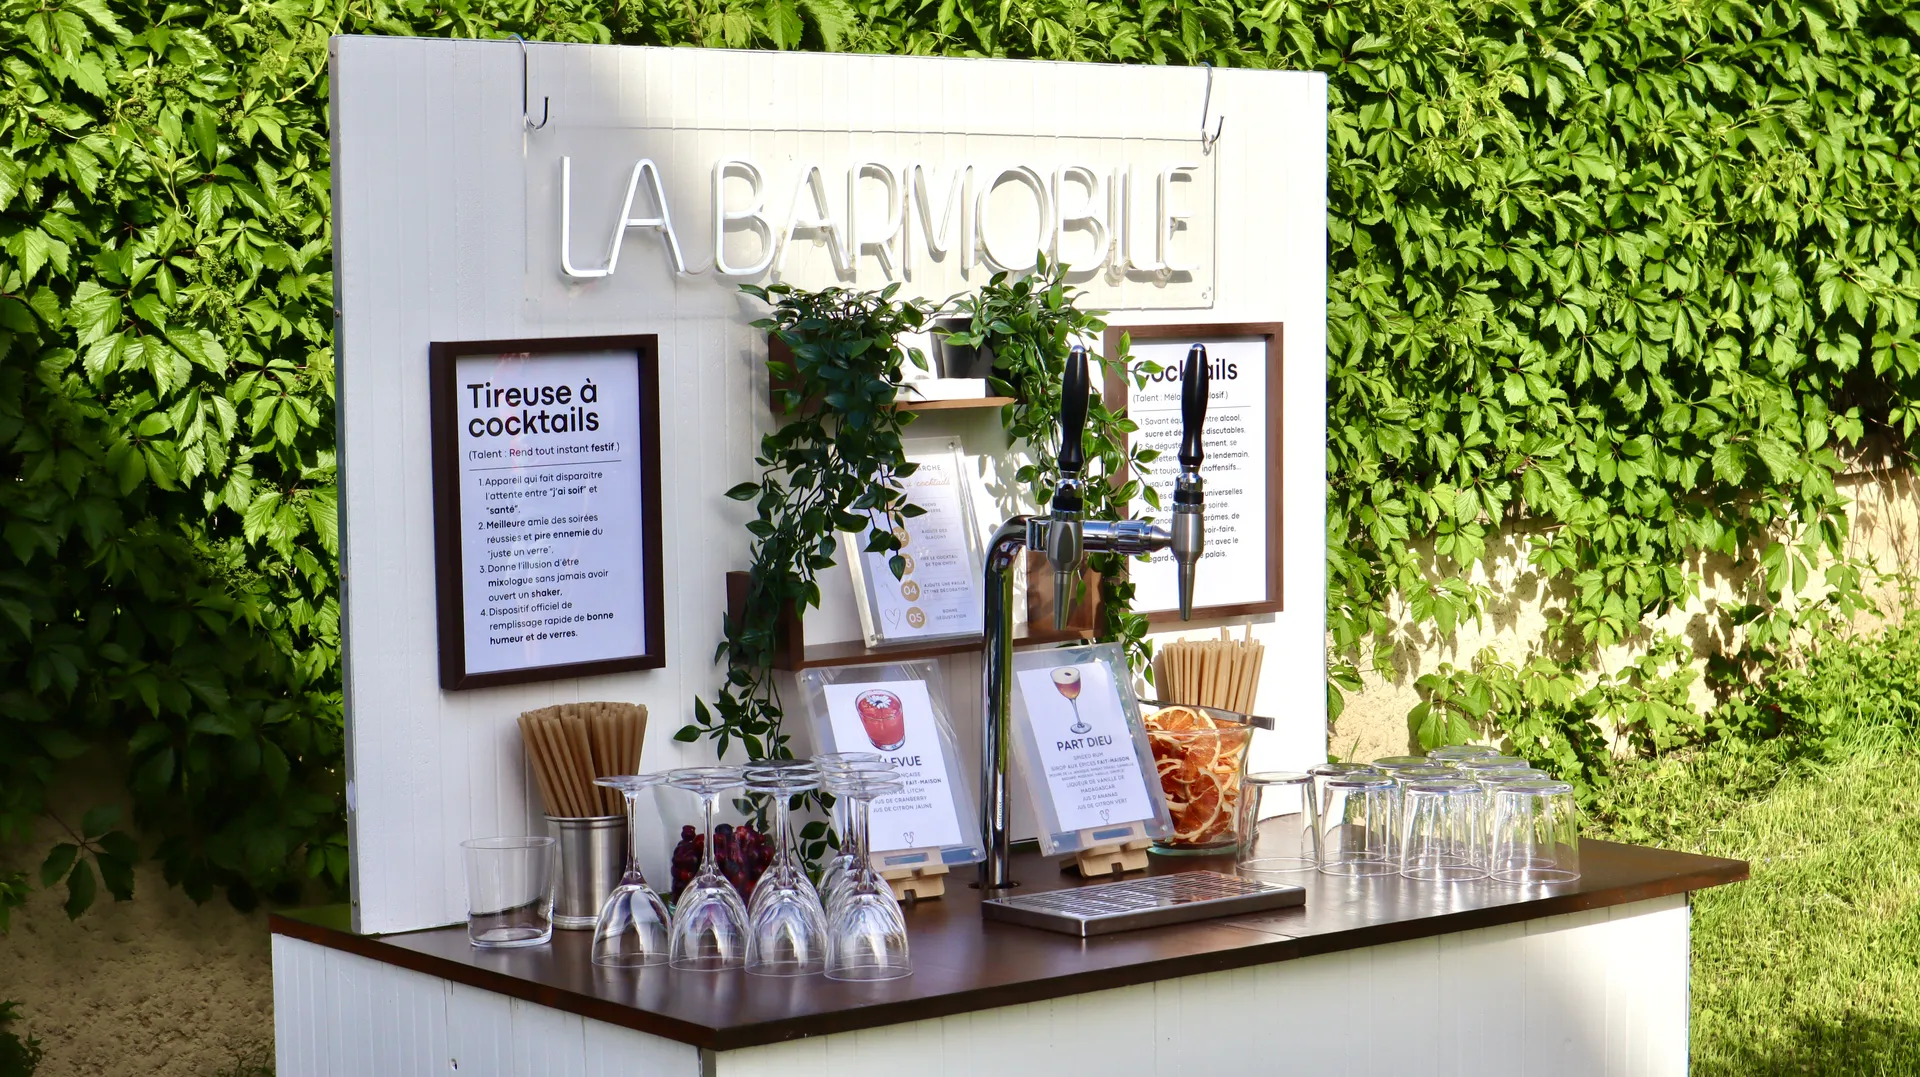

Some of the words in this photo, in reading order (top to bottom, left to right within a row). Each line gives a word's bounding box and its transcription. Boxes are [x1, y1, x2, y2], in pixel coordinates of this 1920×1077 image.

[560, 155, 686, 277] LA
[714, 159, 1200, 277] BARMOBILE
[1134, 358, 1238, 383] ockails
[467, 381, 572, 409] Tireuse
[580, 378, 598, 403] à
[1133, 393, 1159, 404] (Talent
[1164, 392, 1181, 401] Méla
[1209, 390, 1228, 400] losif.)
[468, 406, 600, 438] cocktails
[1145, 417, 1169, 426] Savant
[1165, 429, 1172, 437] et
[469, 449, 502, 461] (Talent
[509, 447, 533, 457] Rend
[535, 446, 555, 456] tout
[556, 444, 589, 455] instant
[591, 441, 620, 453] festif.)
[1205, 452, 1212, 460] le
[1159, 466, 1181, 476] toujou
[485, 475, 522, 489] Appareil
[524, 474, 538, 485] qui
[539, 472, 555, 483] fait
[485, 490, 523, 501] l'attente
[524, 488, 548, 498] entre
[589, 485, 598, 494] et
[1204, 488, 1243, 497] universelles
[486, 518, 526, 530] Meilleure
[527, 516, 549, 527] amie
[551, 515, 567, 525] des
[568, 513, 599, 524] soirées
[1231, 512, 1240, 520] de
[486, 533, 522, 544] réussies
[523, 532, 533, 542] et
[534, 530, 551, 542] pire
[552, 528, 590, 539] ennemie
[592, 526, 603, 536] du
[1232, 536, 1239, 544] le
[513, 548, 525, 557] un
[1150, 554, 1169, 563] egard
[487, 562, 517, 573] Donne
[518, 559, 552, 570] l'illusion
[554, 556, 579, 567] d'être
[488, 576, 533, 588] mixologue
[535, 574, 555, 583] sans
[556, 571, 586, 583] jamais
[587, 569, 609, 579] avoir
[488, 591, 516, 602] ouvert
[518, 590, 530, 599] un
[903, 585, 918, 596] 04
[489, 604, 529, 617] Dispositif
[531, 601, 560, 613] officiel
[561, 601, 573, 610] de
[489, 619, 543, 631] remplissage
[544, 614, 572, 626] rapide
[574, 613, 585, 623] de
[586, 611, 614, 622] bonne
[909, 612, 923, 623] 05
[490, 634, 524, 646] humeur
[525, 633, 535, 642] et
[536, 631, 548, 641] de
[549, 629, 578, 640] verres.
[1056, 738, 1084, 752] PART
[1087, 734, 1113, 748] DIEU
[1097, 756, 1130, 766] FAIT-MAISON
[905, 778, 942, 786] FAIT-MAISON
[1066, 779, 1088, 788] LIQUEUR
[1097, 775, 1117, 783] VANILLE
[1080, 783, 1116, 793] MADAGASCAR
[894, 795, 927, 803] CRANBERRY
[1095, 800, 1114, 808] CITRON
[893, 804, 914, 812] CITRON
[915, 802, 932, 810] JAUNE
